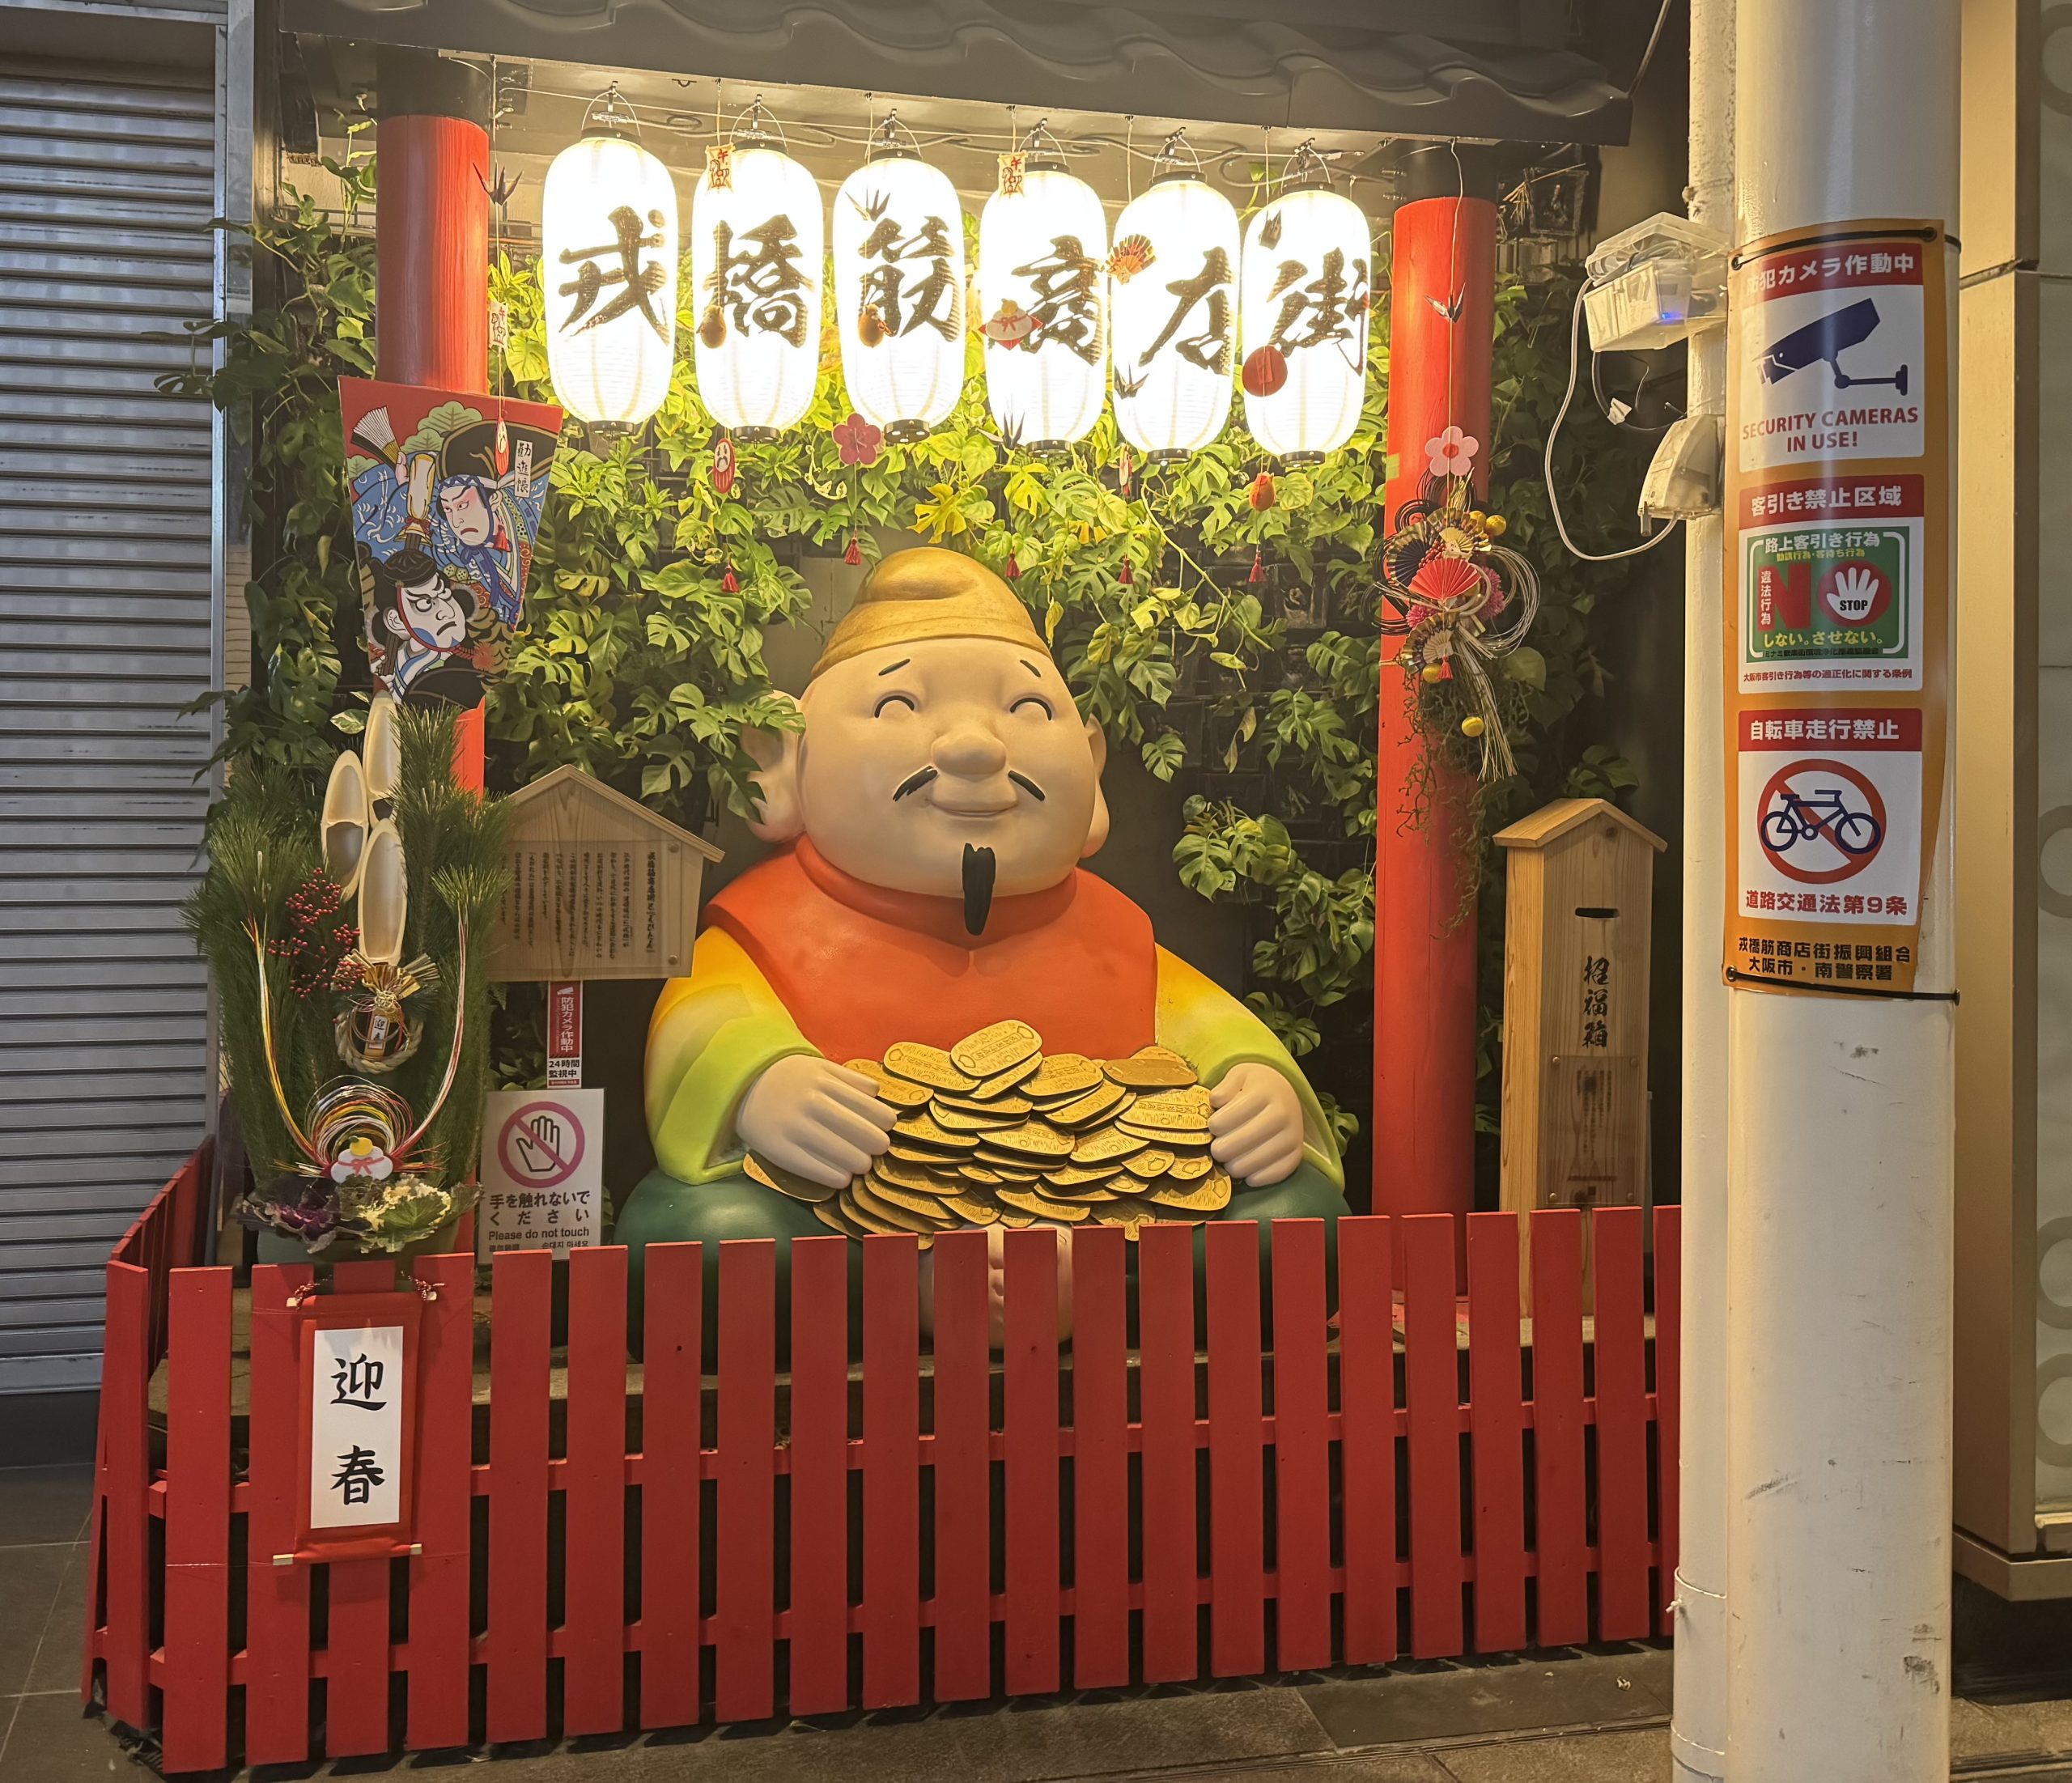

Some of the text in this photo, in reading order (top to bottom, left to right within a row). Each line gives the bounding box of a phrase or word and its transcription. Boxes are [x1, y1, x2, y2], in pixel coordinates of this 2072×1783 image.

[1747, 253, 1914, 295] 防犯カメラ作動中
[1743, 407, 1918, 439] SECURITY CAMERAS
[1787, 431, 1858, 452] IN USE!
[516, 442, 532, 493] 勧進帳
[1751, 486, 1902, 517] 客引き禁止区域
[1765, 531, 1880, 554] 路上客引き行為
[1760, 571, 1772, 626] 違法行為
[1840, 600, 1868, 611] STOP
[1743, 669, 1913, 684] 大阪市客引き行為等の適正化に関する条例
[1751, 719, 1900, 741] 自転車走行禁止
[1746, 889, 1908, 916] 道路交通法第9条
[1739, 936, 1910, 963] 戎橋筋商店街振興組合
[560, 996, 574, 1052] 防犯カメラ作動中
[549, 1059, 580, 1068] 24時間
[549, 1069, 577, 1078] 監視中
[490, 1191, 590, 1209] 手を触れないで
[488, 1226, 589, 1241] Please do not touch
[330, 1353, 387, 1505] 迎春
